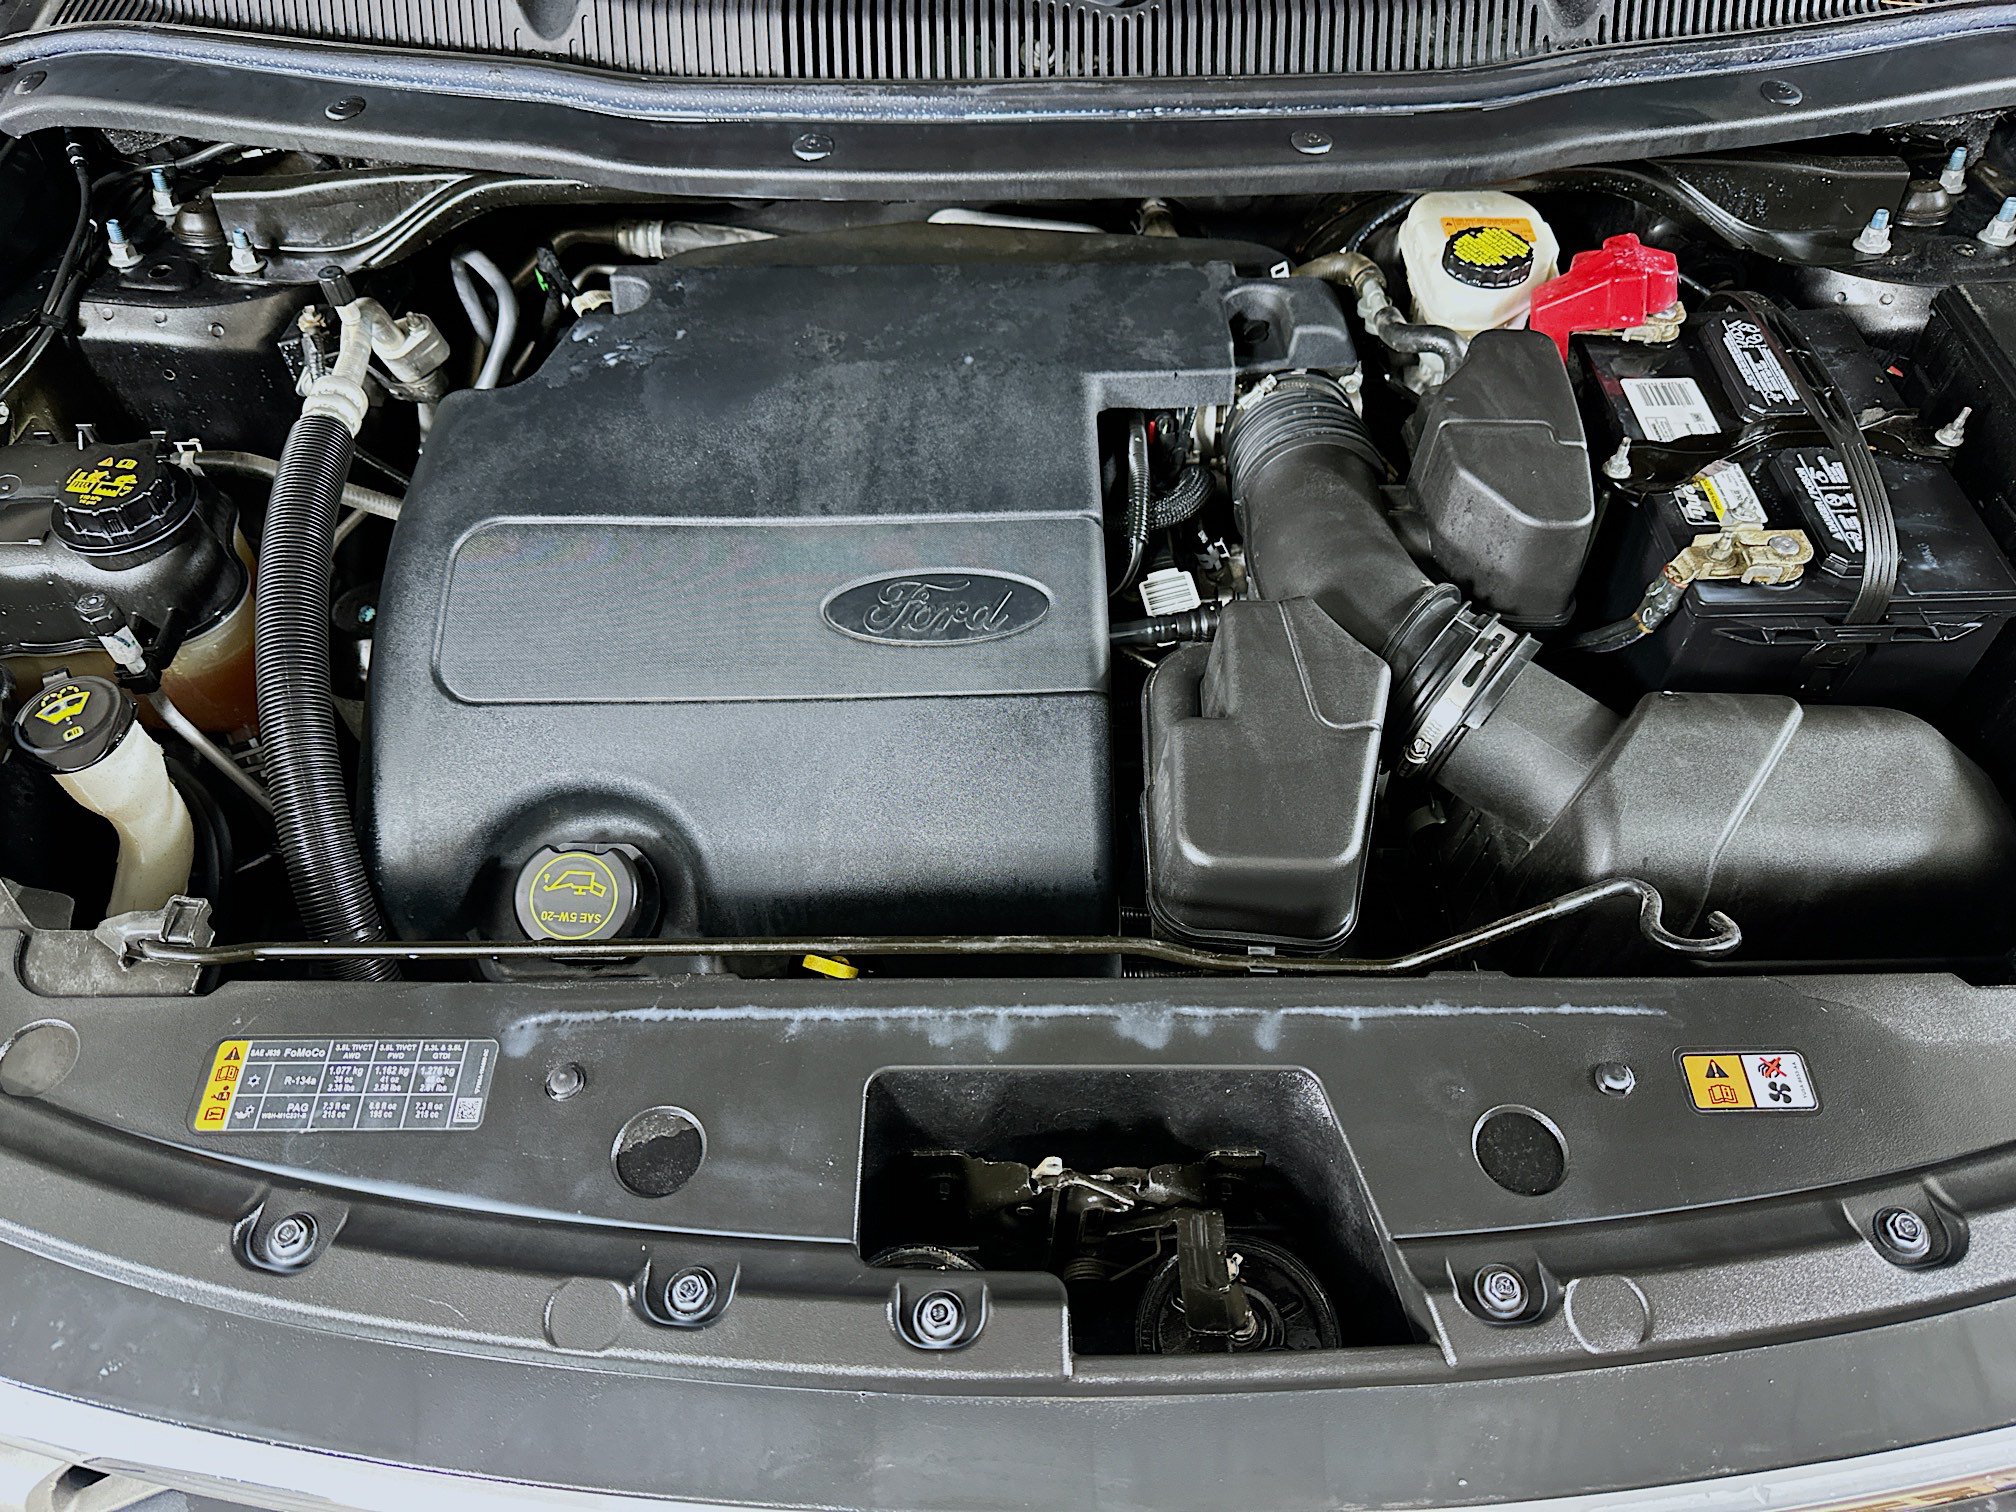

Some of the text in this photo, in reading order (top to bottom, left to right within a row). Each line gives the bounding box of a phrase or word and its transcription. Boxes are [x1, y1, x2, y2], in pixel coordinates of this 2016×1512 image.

[863, 581, 1013, 634] Ford
[540, 910, 602, 924] SAE 5W-20
[283, 1047, 326, 1058] FoMoCo
[342, 1052, 361, 1060] AWD
[387, 1052, 405, 1060] FWD
[329, 1065, 364, 1077] 1.077 kg
[375, 1065, 410, 1077] 1.162 kg
[443, 1065, 456, 1077] kg
[283, 1075, 317, 1086] R-134a
[286, 1102, 310, 1112] PAG
